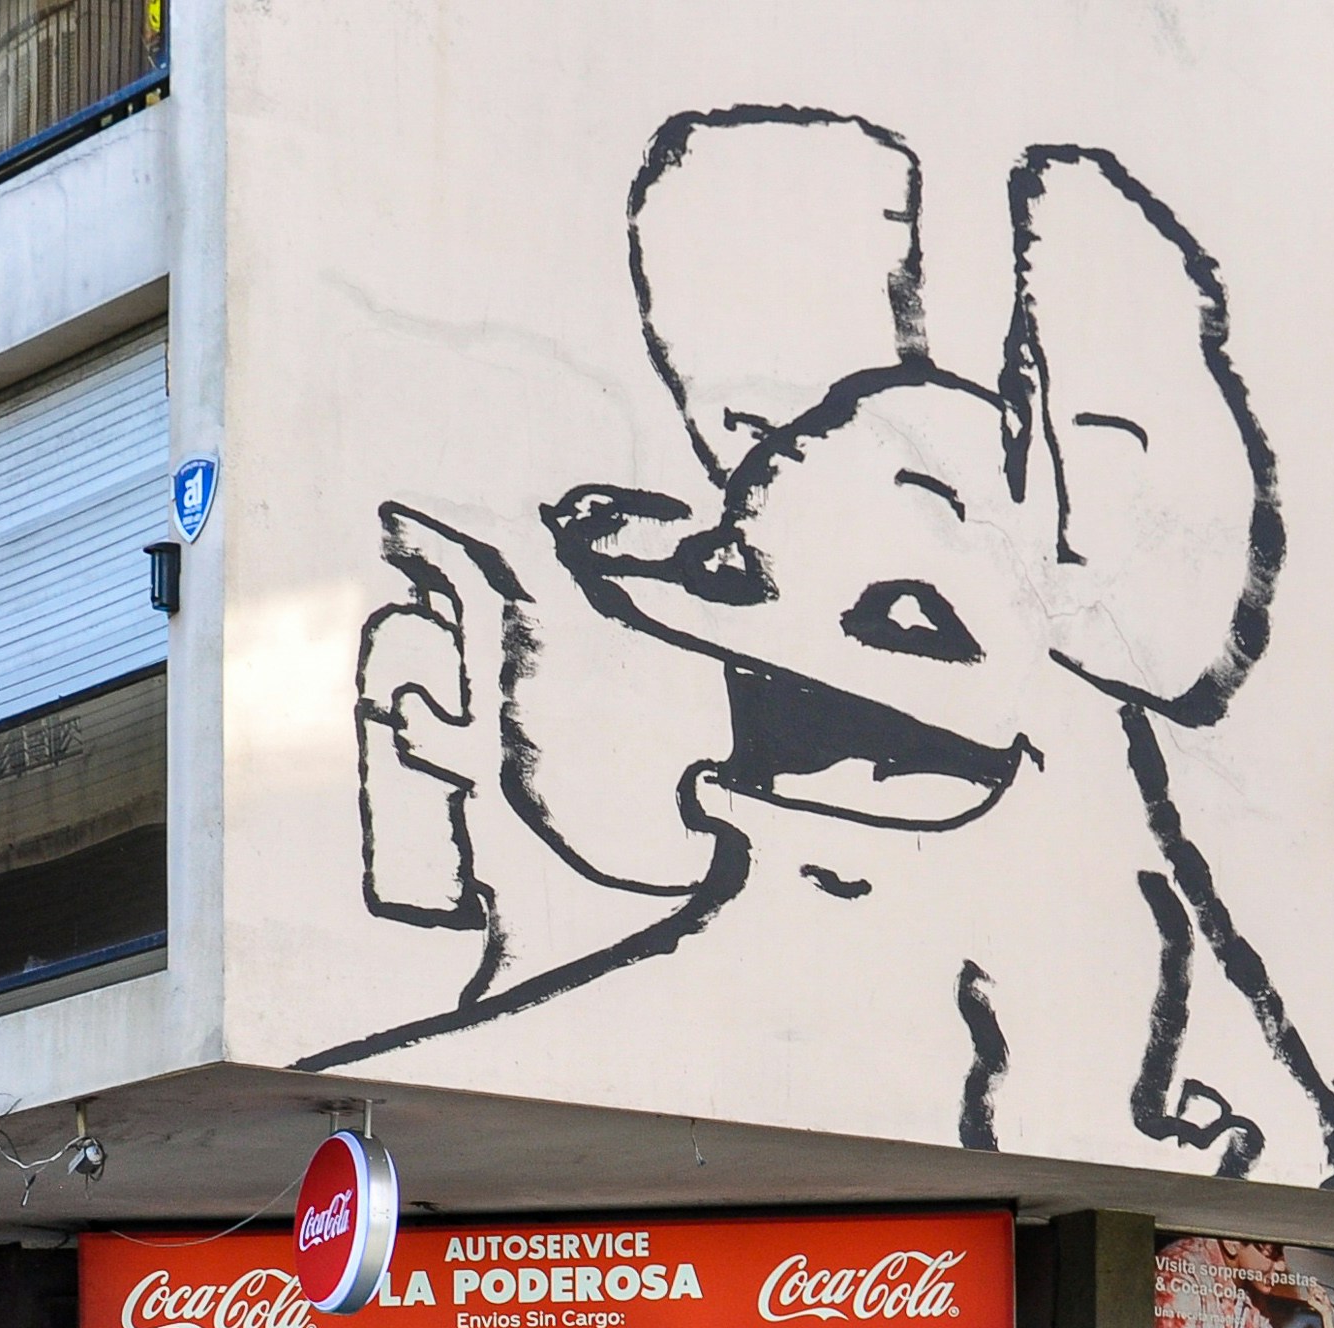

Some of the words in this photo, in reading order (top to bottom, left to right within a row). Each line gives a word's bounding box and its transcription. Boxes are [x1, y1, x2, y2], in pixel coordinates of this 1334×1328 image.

[299, 1189, 353, 1252] Coca-Cola
[444, 1232, 649, 1262] AUTOSERVICE
[379, 1271, 436, 1306] LA
[453, 1263, 703, 1305] PODEROSA
[758, 1250, 967, 1322] Coca-Cola
[1155, 1256, 1196, 1274] Visita
[1200, 1264, 1267, 1284] sorpresa,
[1271, 1272, 1317, 1287] pastas
[1155, 1277, 1165, 1291] &
[456, 1312, 520, 1328] Envios
[526, 1311, 556, 1327] Sin
[562, 1310, 626, 1328] Cargo:
